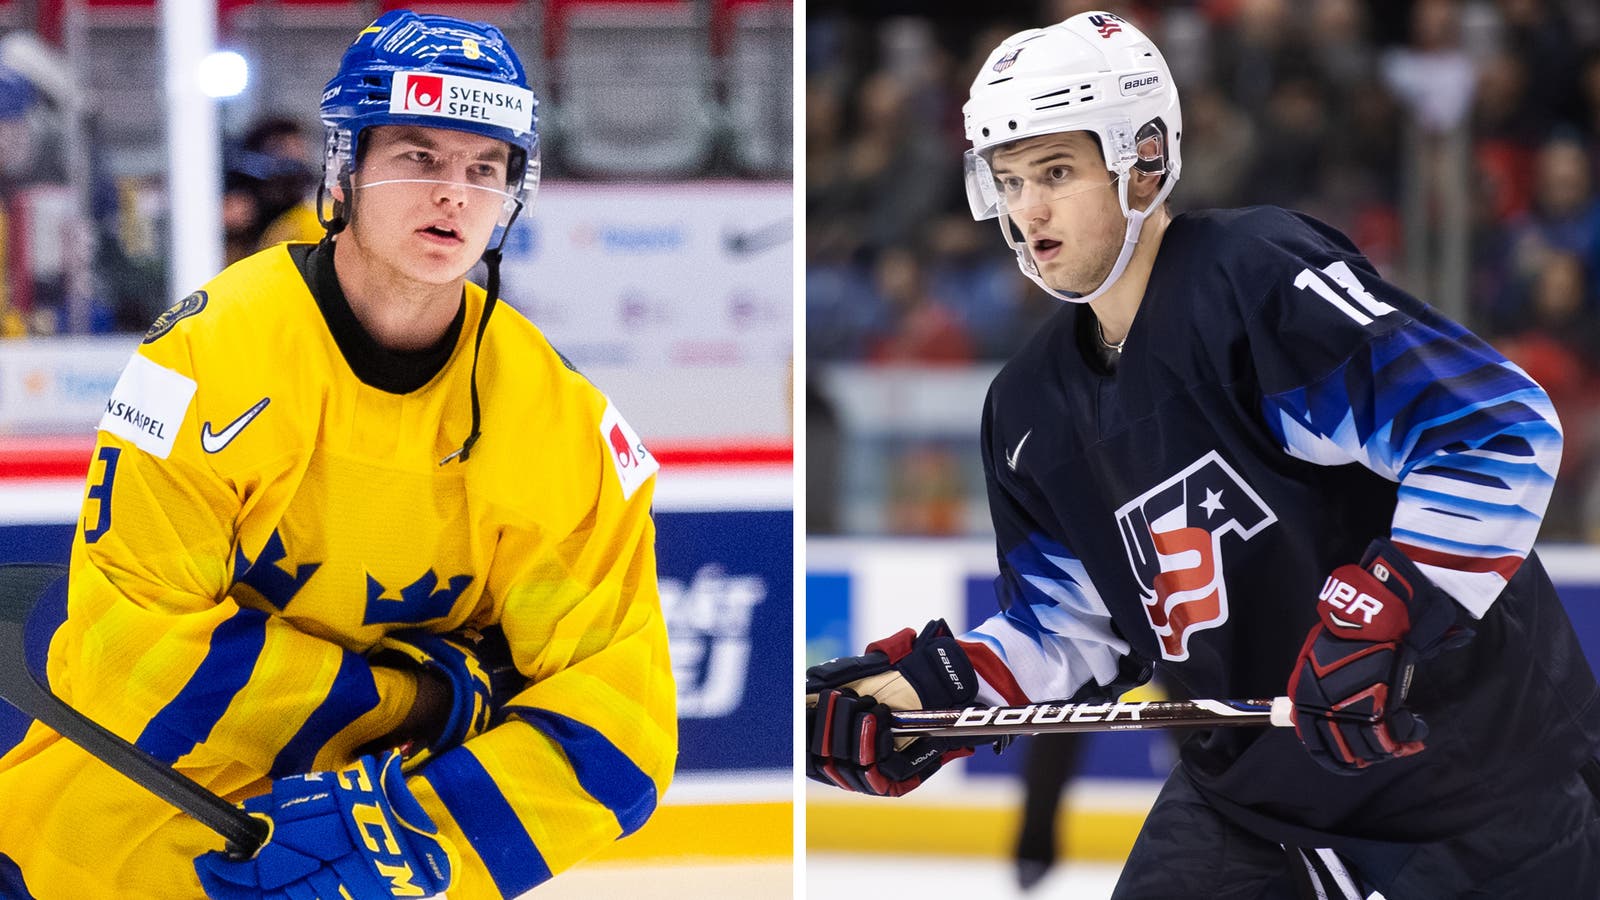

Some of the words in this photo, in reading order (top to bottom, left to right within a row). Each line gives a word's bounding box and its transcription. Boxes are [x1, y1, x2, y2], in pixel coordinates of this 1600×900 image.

[449, 86, 523, 113] SVENSKA
[1124, 75, 1159, 90] BAUER
[448, 102, 491, 121] SPEL
[1114, 449, 1279, 663] USA
[936, 647, 965, 691] BAUER
[337, 759, 426, 897] CCM
